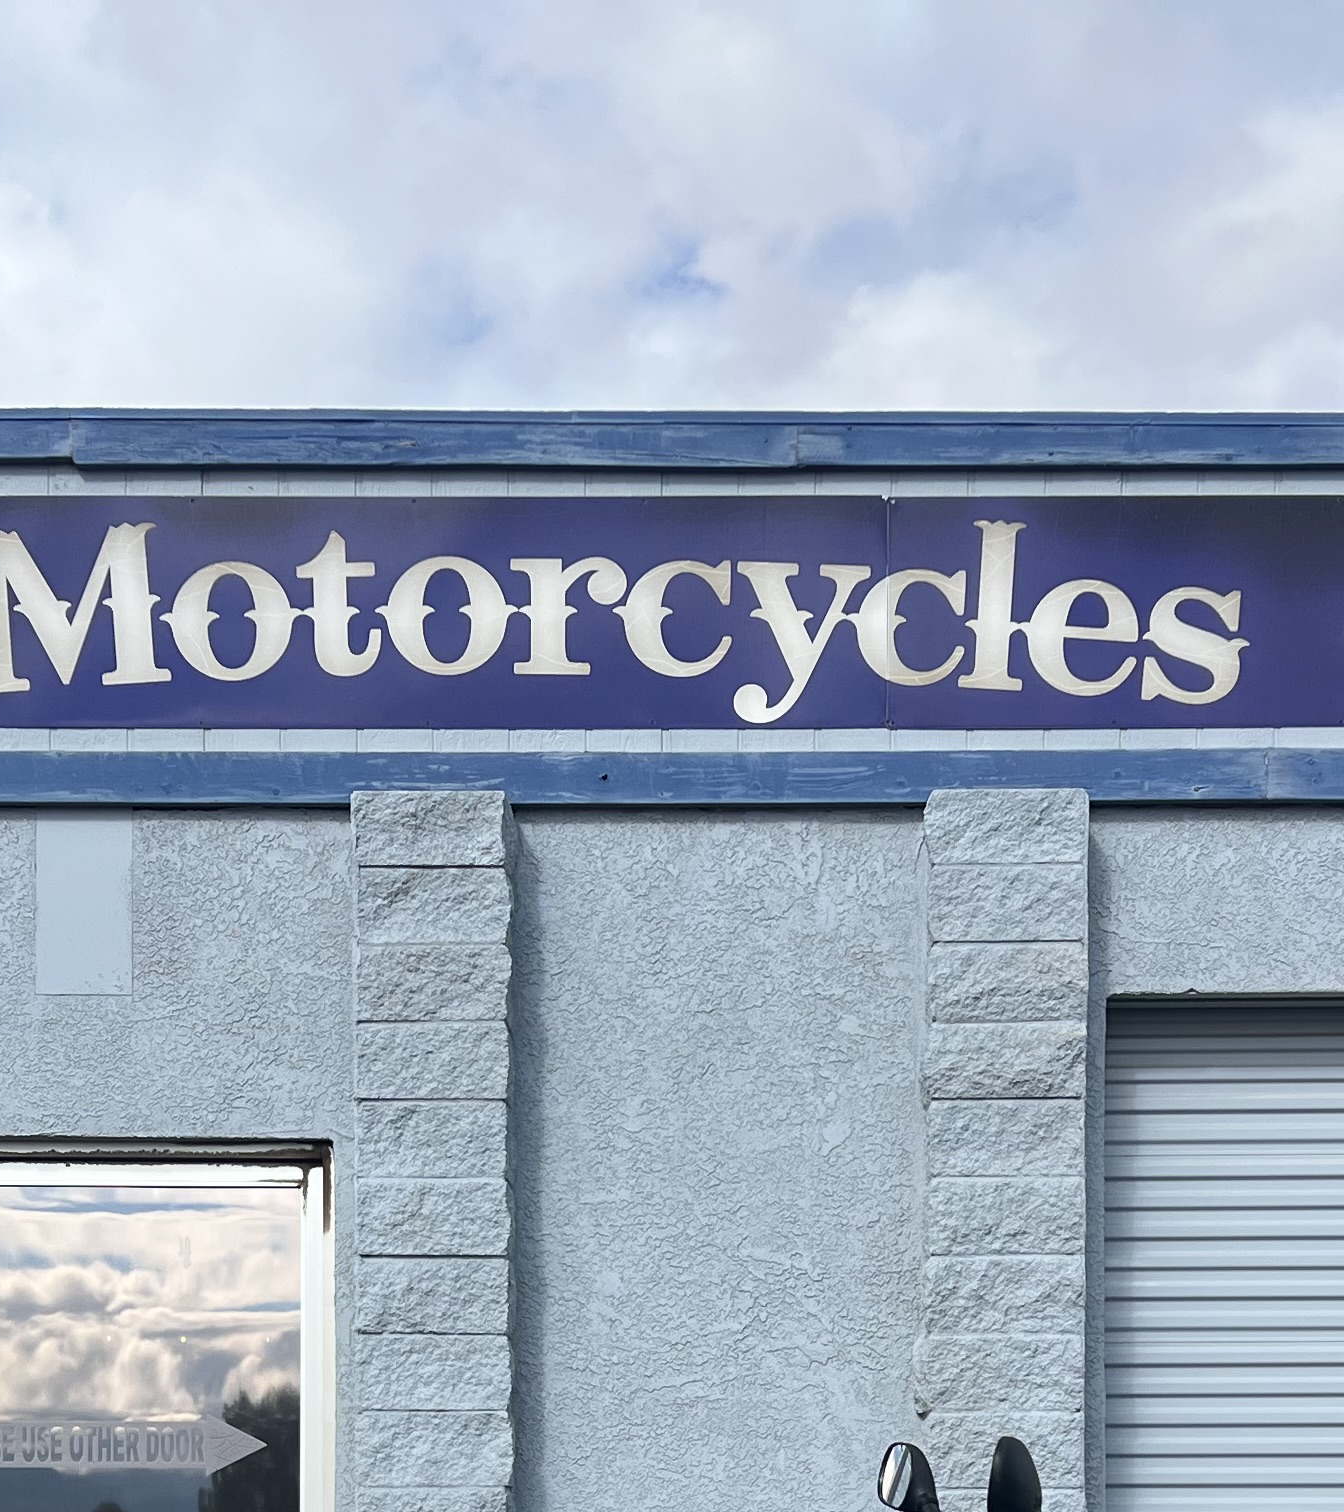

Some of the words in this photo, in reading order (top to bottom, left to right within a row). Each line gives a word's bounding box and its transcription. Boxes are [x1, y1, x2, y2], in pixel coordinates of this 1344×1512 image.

[21, 1425, 63, 1463] USE
[69, 1425, 140, 1463] OTHER
[146, 1425, 205, 1463] DOOR
